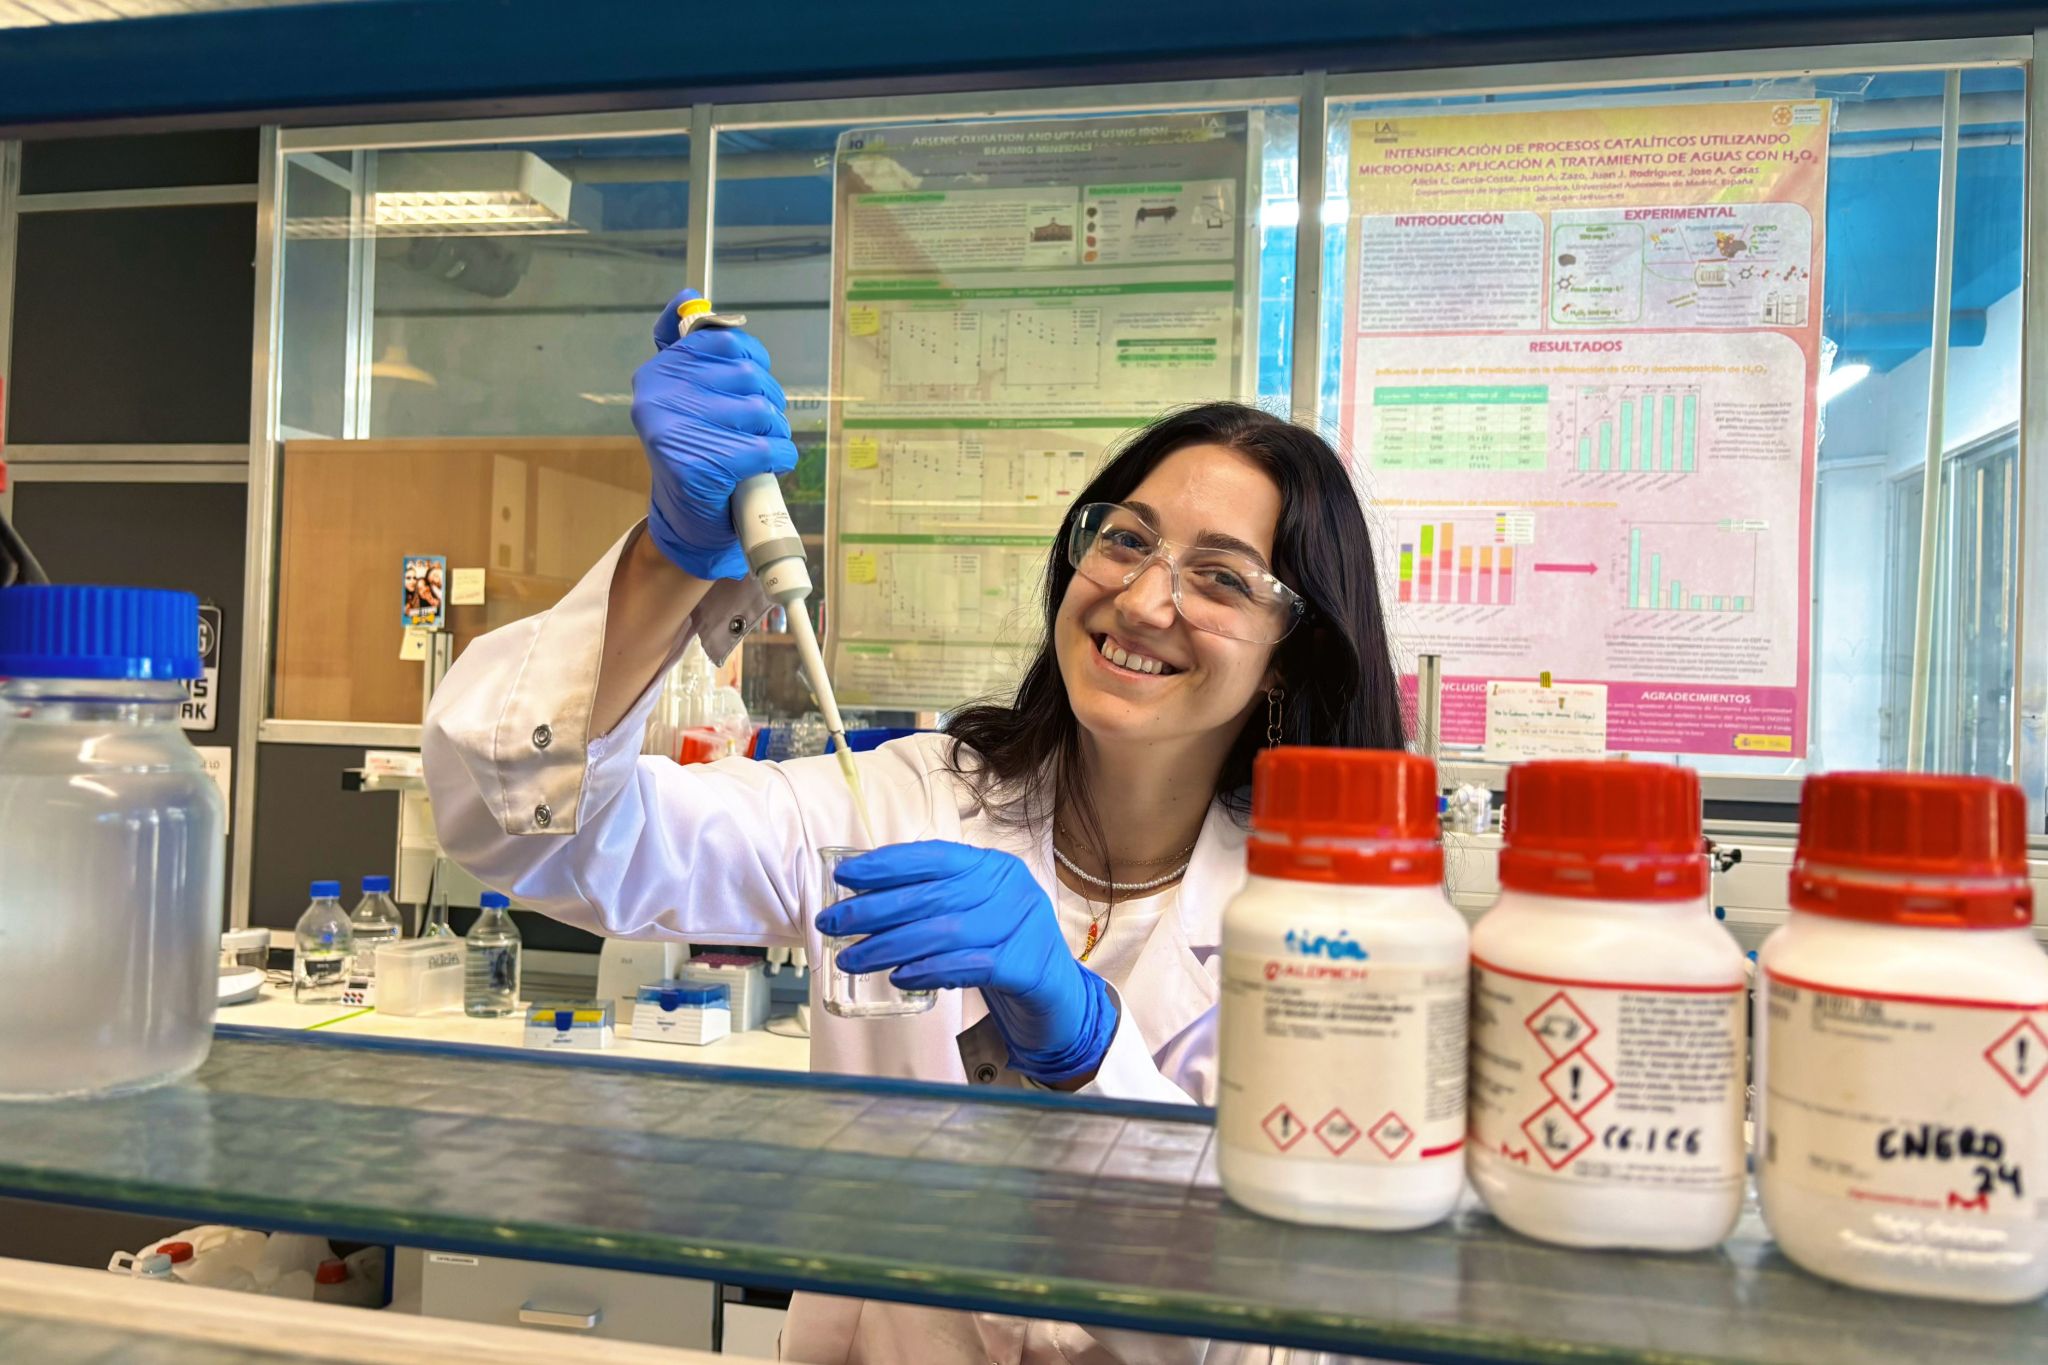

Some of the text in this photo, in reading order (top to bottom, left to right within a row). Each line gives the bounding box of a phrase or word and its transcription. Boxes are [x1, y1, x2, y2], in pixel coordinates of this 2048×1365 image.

[912, 126, 1168, 147] ARSENIC OXIDATION AND UPTAKE USING IRON
[983, 144, 1033, 156] BEARING
[1384, 132, 1791, 160] INTENSIFICACIÓN DE PROCESOS CATALÍTICOS UTILIZANDO
[1358, 162, 1456, 177] MICROONDAS:
[1457, 157, 1542, 173] APLICACIÓN
[1545, 158, 1556, 168] A
[1560, 152, 1663, 169] TRATAMIENTO
[1667, 152, 1687, 164] DE
[1690, 150, 1742, 163] AGUAS
[1746, 149, 1778, 161] CON
[1591, 171, 1616, 180] Juan
[1729, 165, 1760, 175] Casas
[1394, 213, 1505, 228] INTRODUCCIÓN
[1624, 207, 1737, 221] EXPERIMENTAL
[1529, 340, 1623, 353] RESULTADOS
[1640, 691, 1752, 704] AGRADECIMIENTOS
[181, 703, 208, 720] RK
[1974, 1165, 2023, 1198] 24
